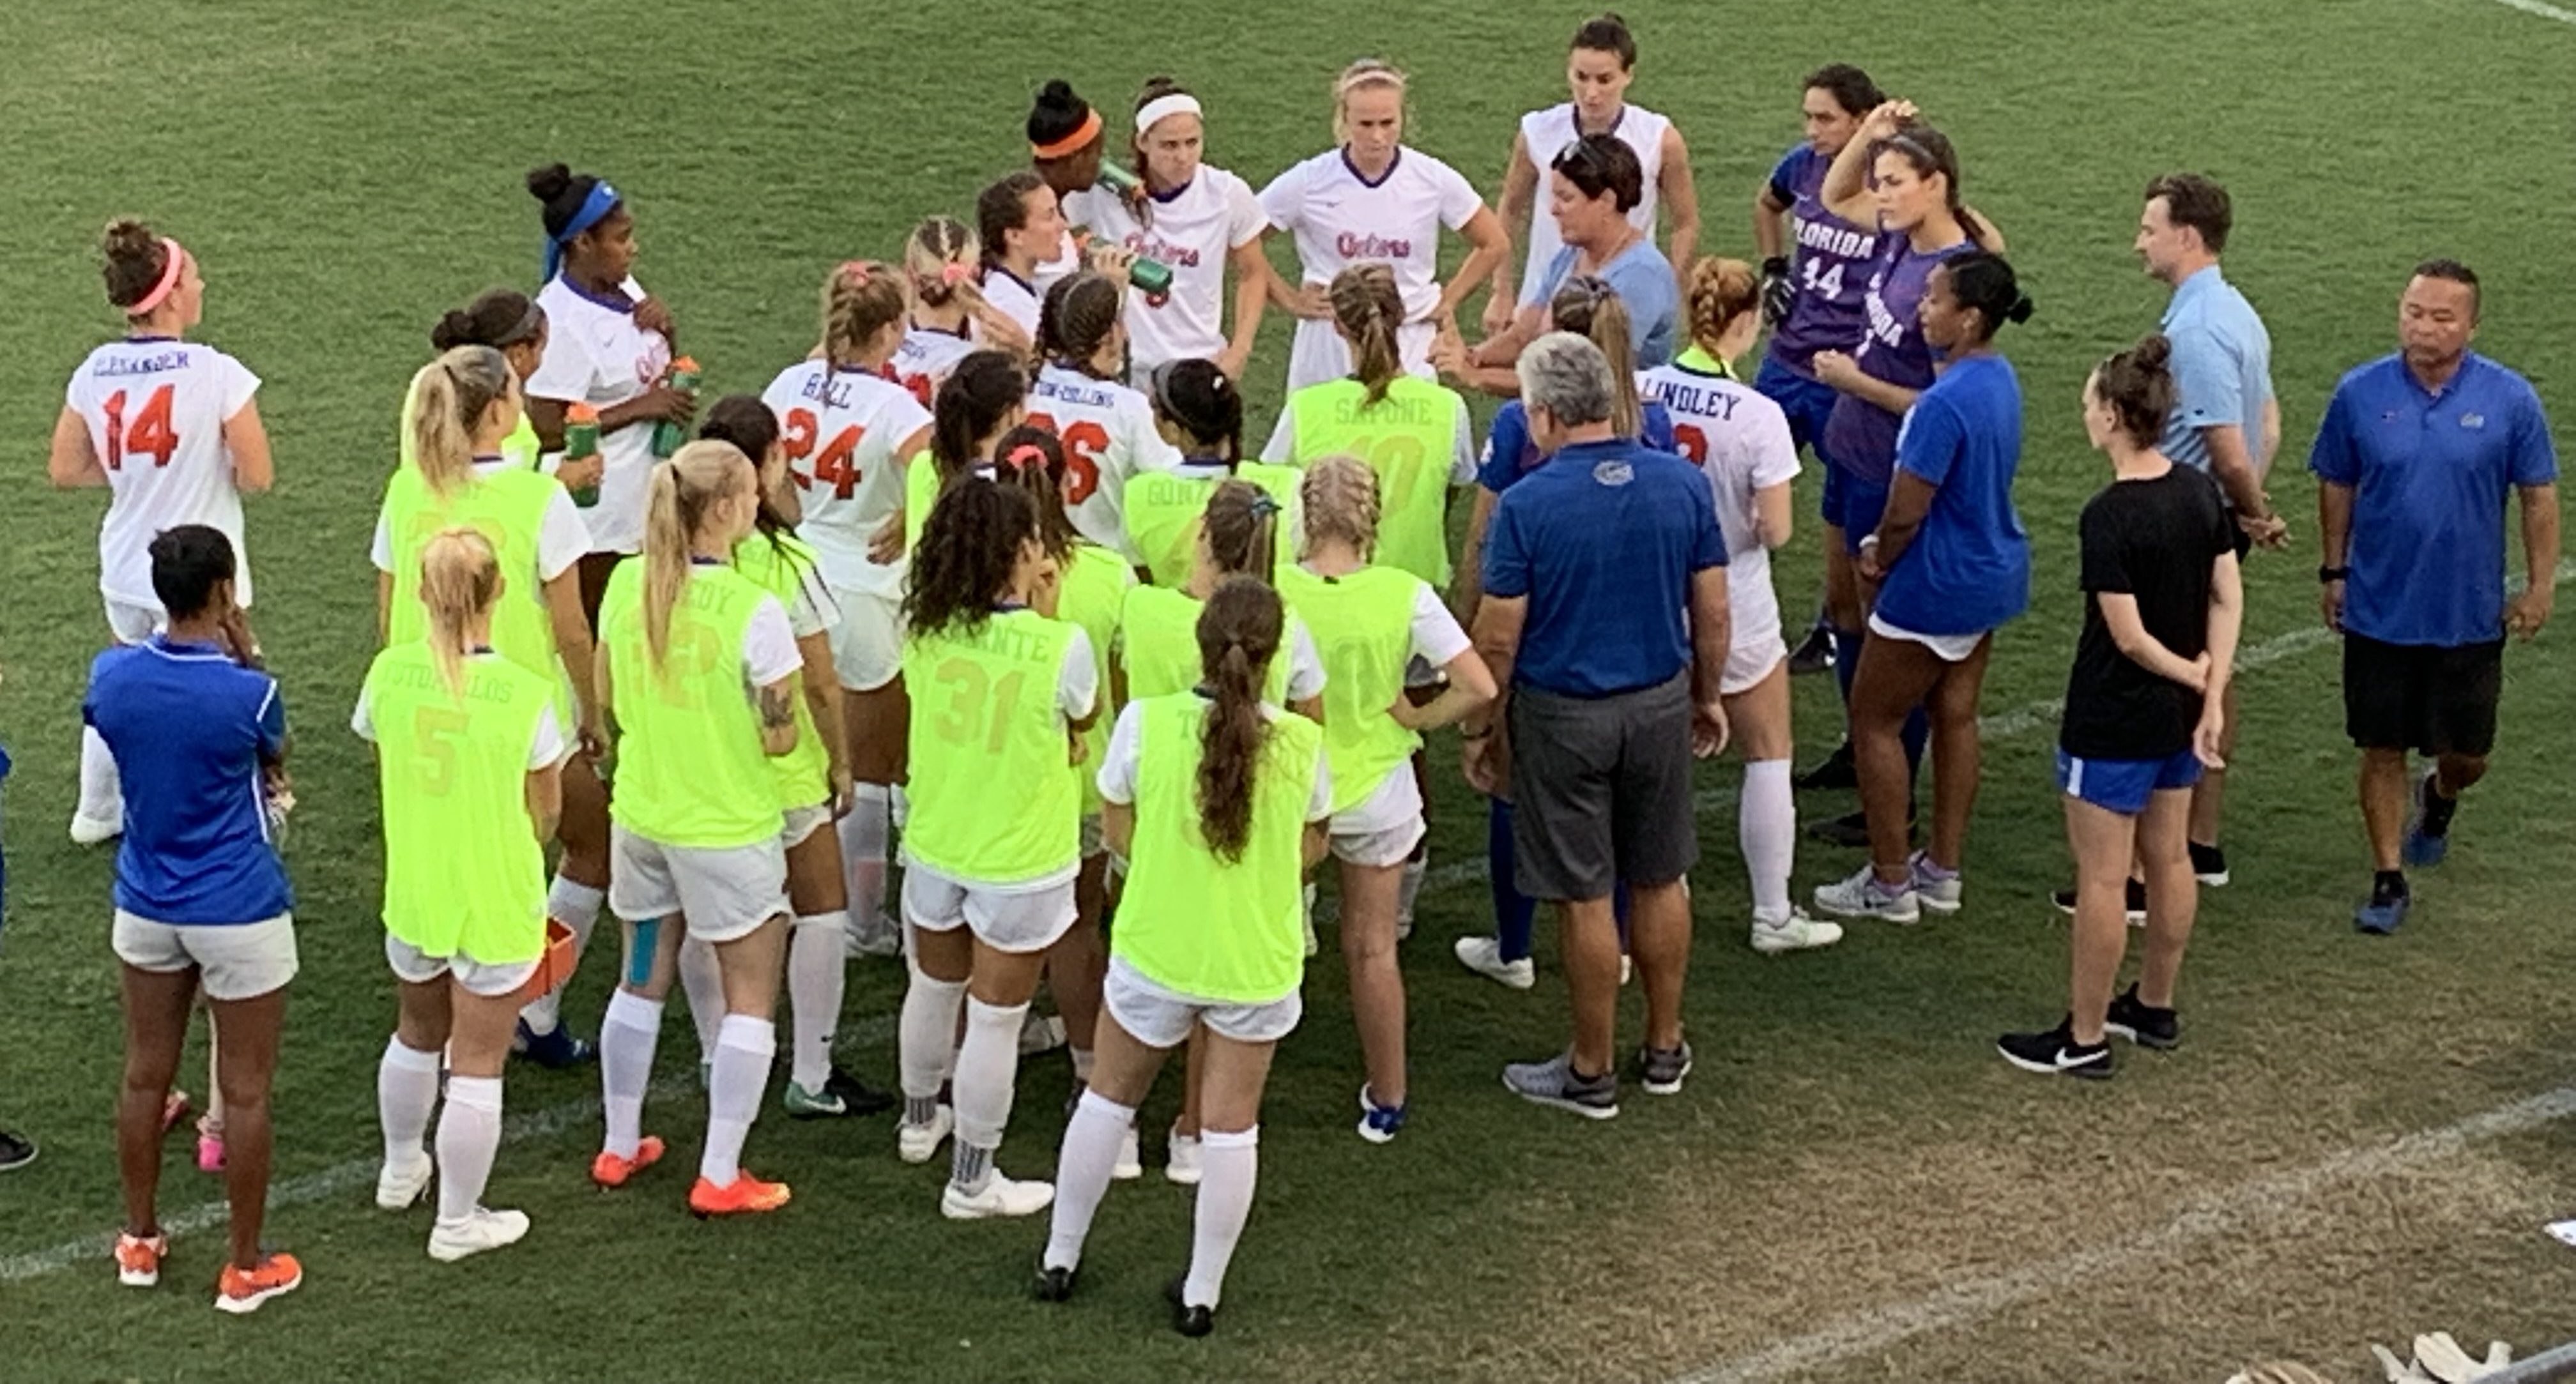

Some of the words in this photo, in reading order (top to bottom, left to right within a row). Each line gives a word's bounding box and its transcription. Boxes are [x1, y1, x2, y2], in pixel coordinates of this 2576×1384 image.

[1803, 257, 1844, 300] 14
[103, 383, 178, 471] 14
[1643, 378, 1741, 421] LINDLEY
[783, 407, 865, 500] 24
[934, 657, 1025, 755] 31
[415, 705, 470, 798] 5
